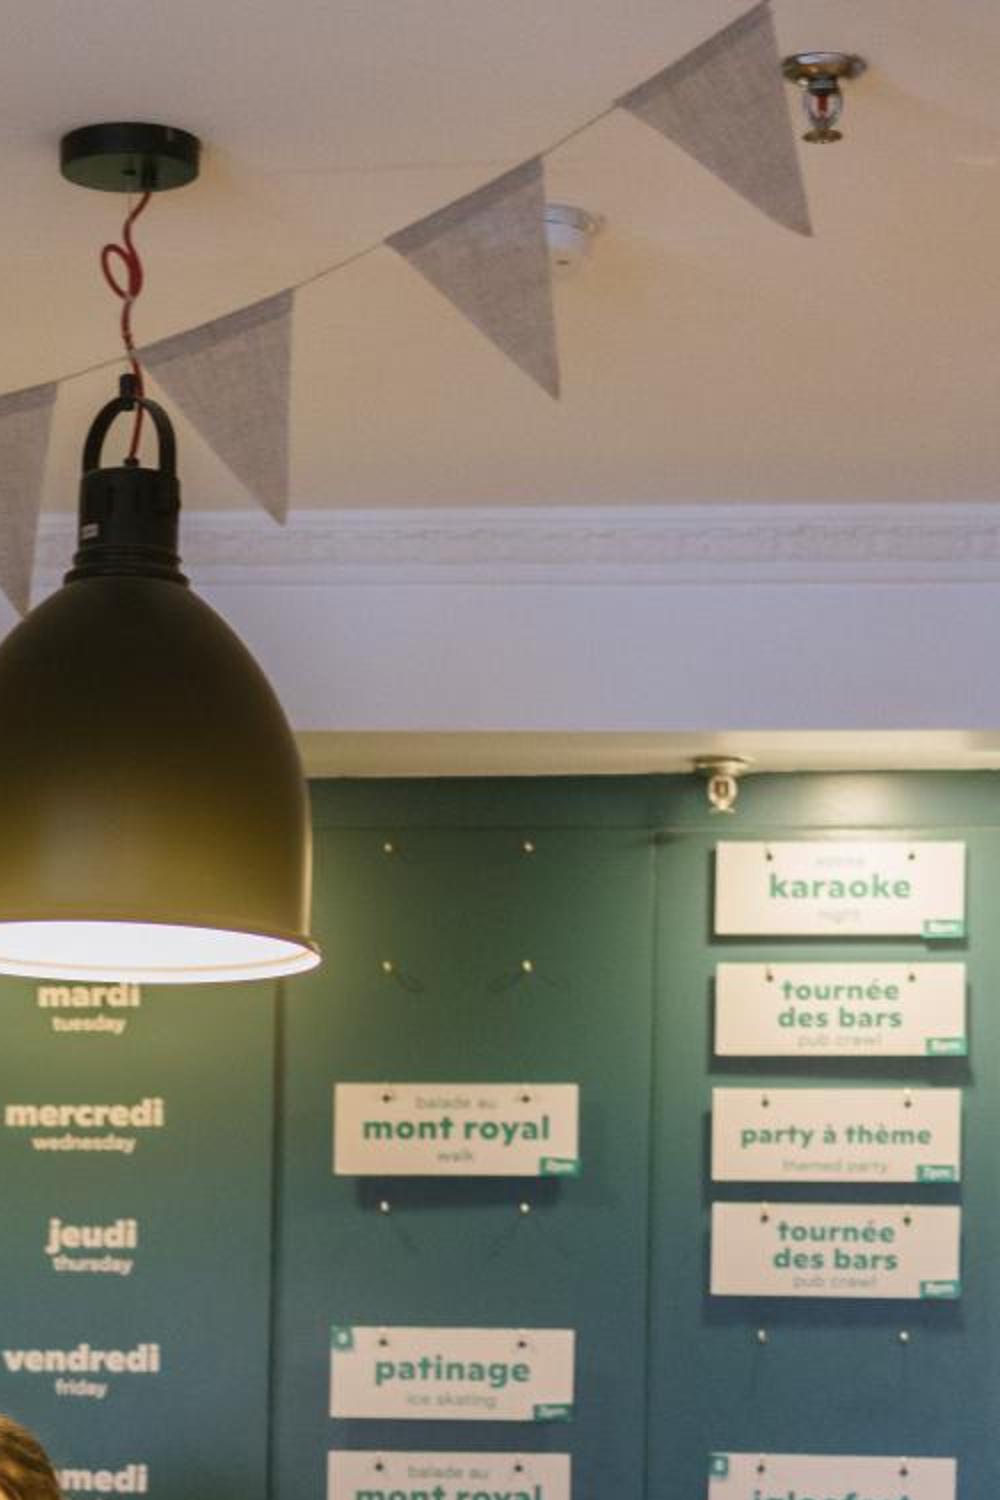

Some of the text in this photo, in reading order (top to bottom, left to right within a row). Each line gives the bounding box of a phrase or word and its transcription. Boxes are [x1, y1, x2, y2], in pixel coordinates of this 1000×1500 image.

[768, 873, 912, 899] karaoke
[37, 981, 140, 1008] mardi
[781, 976, 900, 1001] tournée
[52, 1014, 127, 1035] tuesday
[777, 1006, 903, 1029] des bars
[4, 1097, 165, 1127] mercredi
[363, 1114, 550, 1147] mont royal
[741, 1124, 932, 1148] party à thème
[31, 1134, 137, 1154] wednesday
[45, 1217, 138, 1255] jeudi
[777, 1219, 896, 1243] tournée
[52, 1255, 134, 1276] thursday
[773, 1248, 899, 1271] des bars
[1, 1342, 161, 1373] vendredi
[375, 1354, 532, 1389] patinage
[54, 1378, 108, 1399] friday
[56, 1464, 148, 1494] medi
